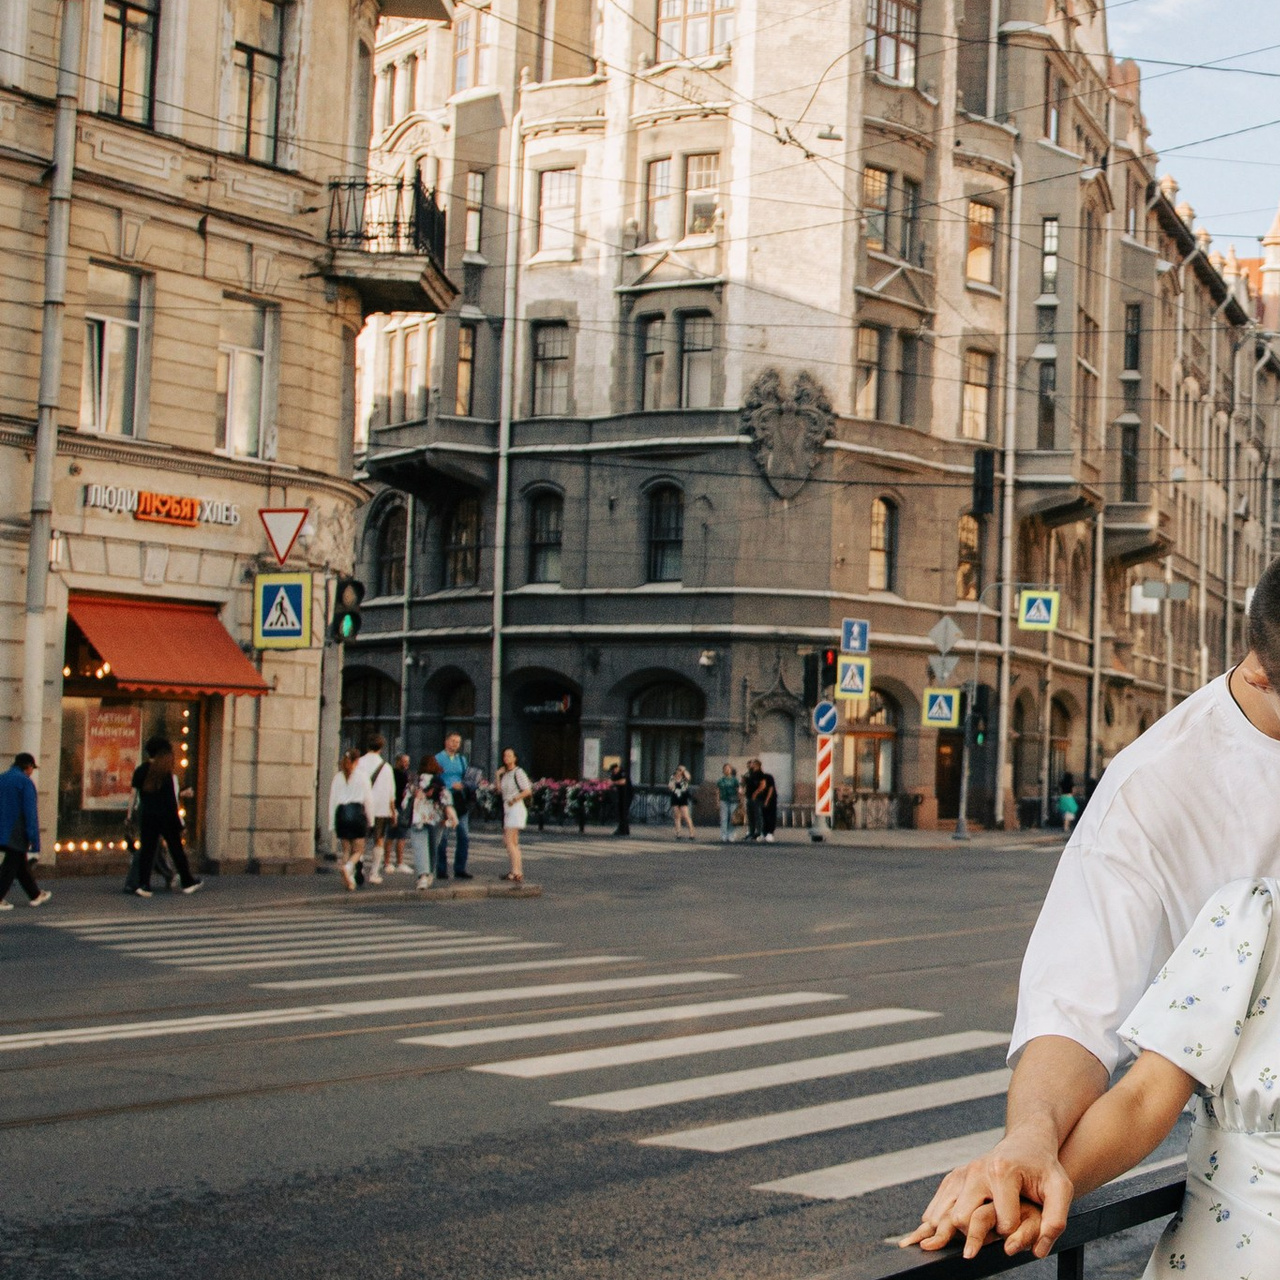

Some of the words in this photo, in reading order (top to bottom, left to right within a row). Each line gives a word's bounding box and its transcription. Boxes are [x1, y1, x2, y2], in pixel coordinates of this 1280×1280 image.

[89, 484, 139, 514] ЛЮДИ
[202, 499, 241, 526] ХЛЕБ
[90, 726, 136, 737] НАПИТКИ
